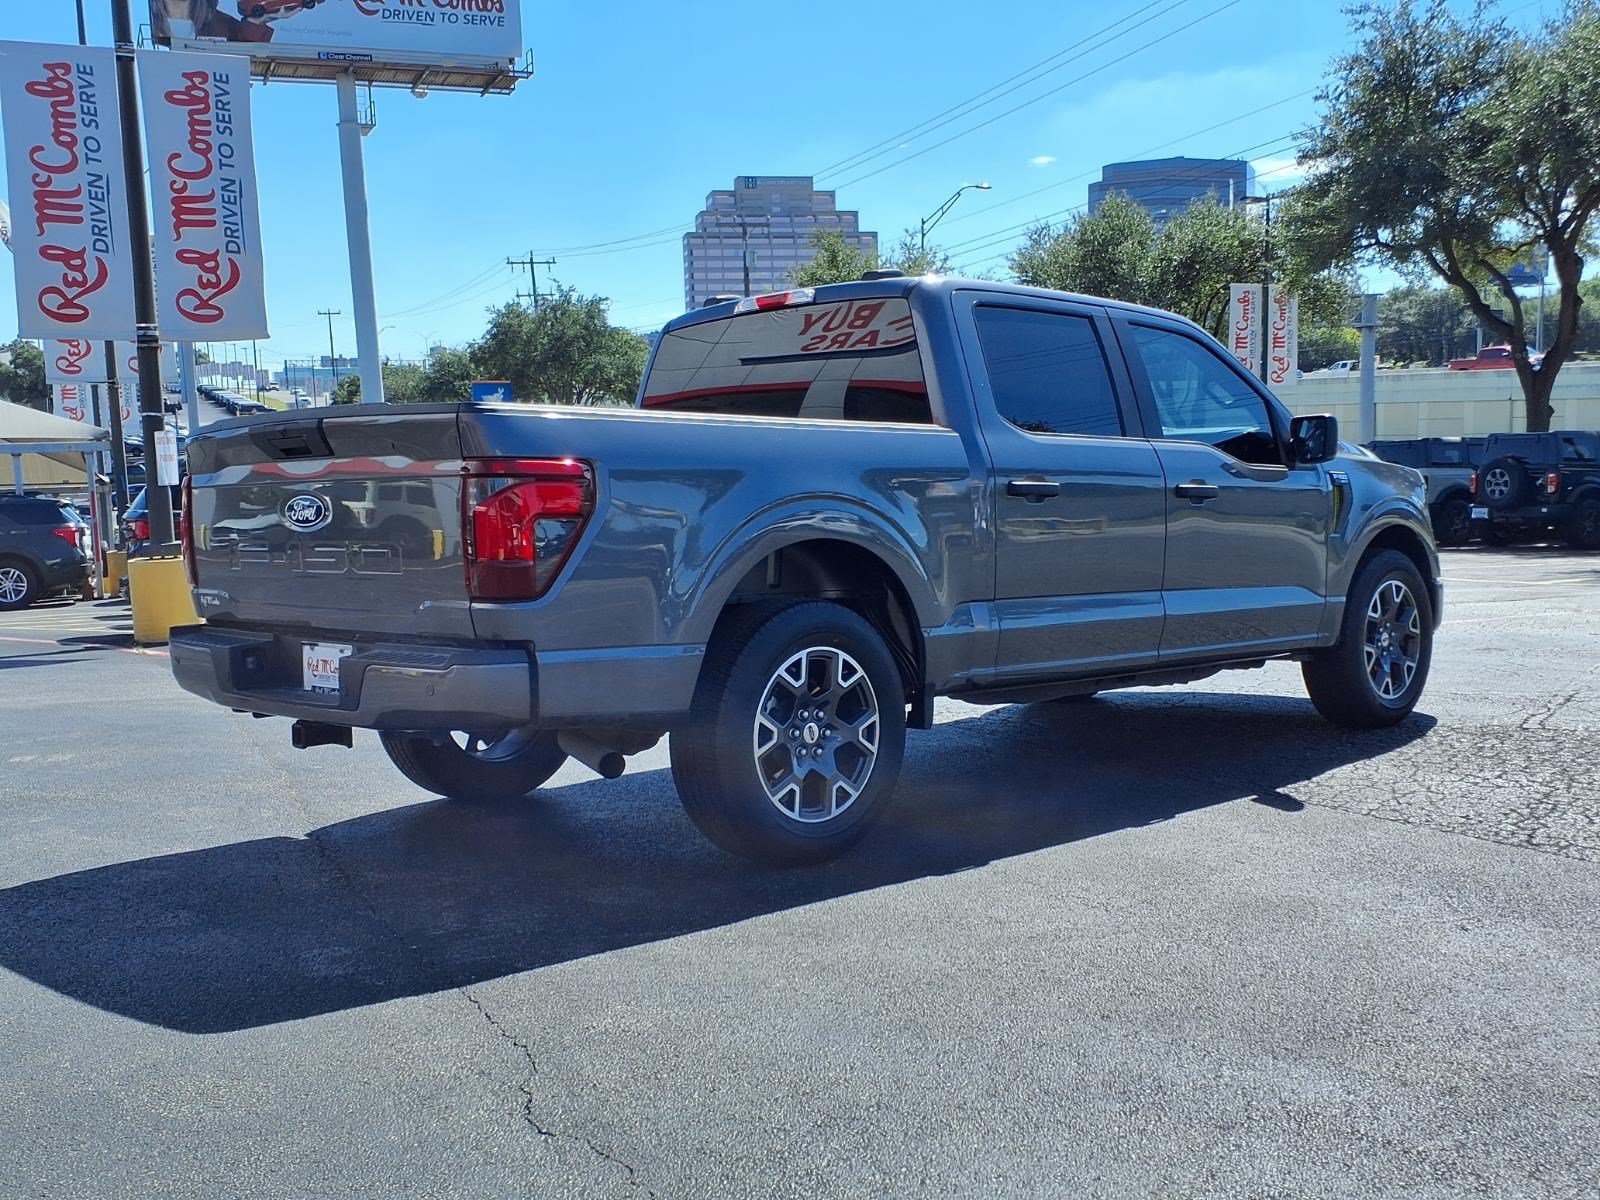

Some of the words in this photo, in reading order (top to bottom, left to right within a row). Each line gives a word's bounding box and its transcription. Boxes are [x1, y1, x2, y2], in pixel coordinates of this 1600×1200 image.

[381, 8, 435, 23] DRIVEN
[440, 12, 459, 24] TO
[463, 13, 505, 27] SERVE
[345, 54, 371, 62] Channel
[76, 63, 99, 130] SERVE
[212, 71, 233, 137] SERVE
[25, 62, 84, 236] McCombs
[83, 135, 102, 165] TO
[164, 71, 217, 242] McCombs
[217, 142, 235, 170] TO
[86, 172, 110, 254] DRIVEN
[220, 177, 242, 255] DRIVEN
[38, 244, 109, 323] Red
[175, 248, 240, 323] Red
[1270, 355, 1290, 383] Red
[291, 500, 319, 521] Ford
[306, 656, 320, 678] Red
